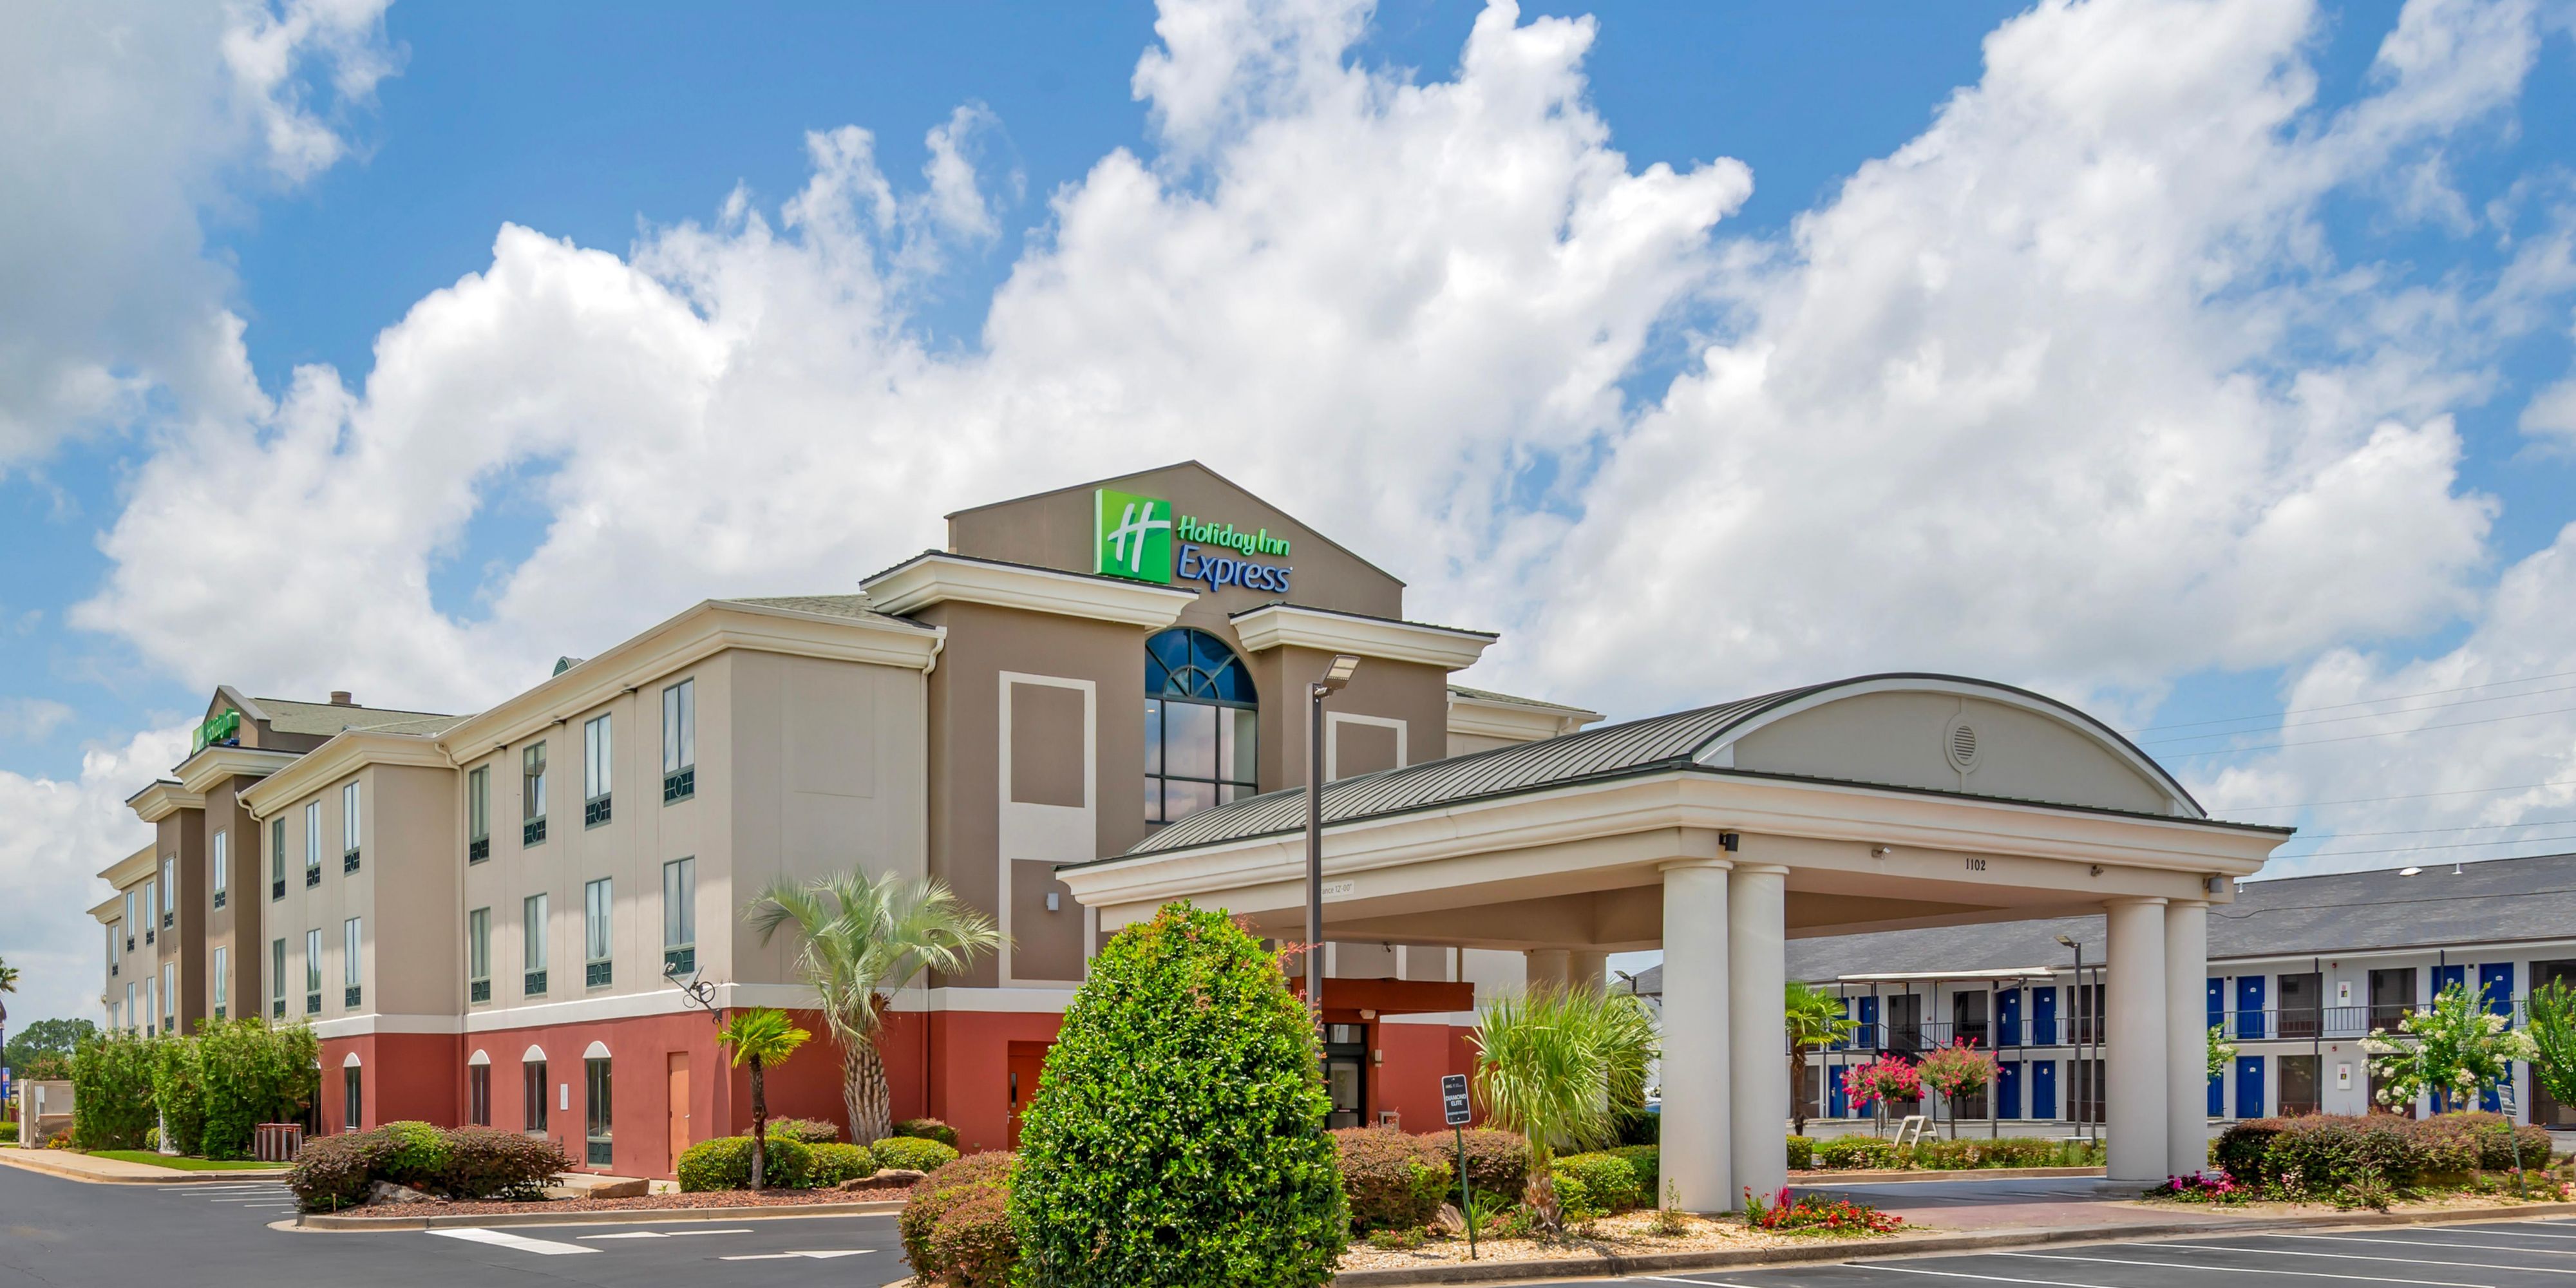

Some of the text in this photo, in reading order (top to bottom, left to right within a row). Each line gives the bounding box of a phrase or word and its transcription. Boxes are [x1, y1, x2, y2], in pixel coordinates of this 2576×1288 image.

[1177, 515, 1291, 556] Holiday Inn
[1177, 544, 1290, 592] Express
[1966, 858, 1985, 871] 1102
